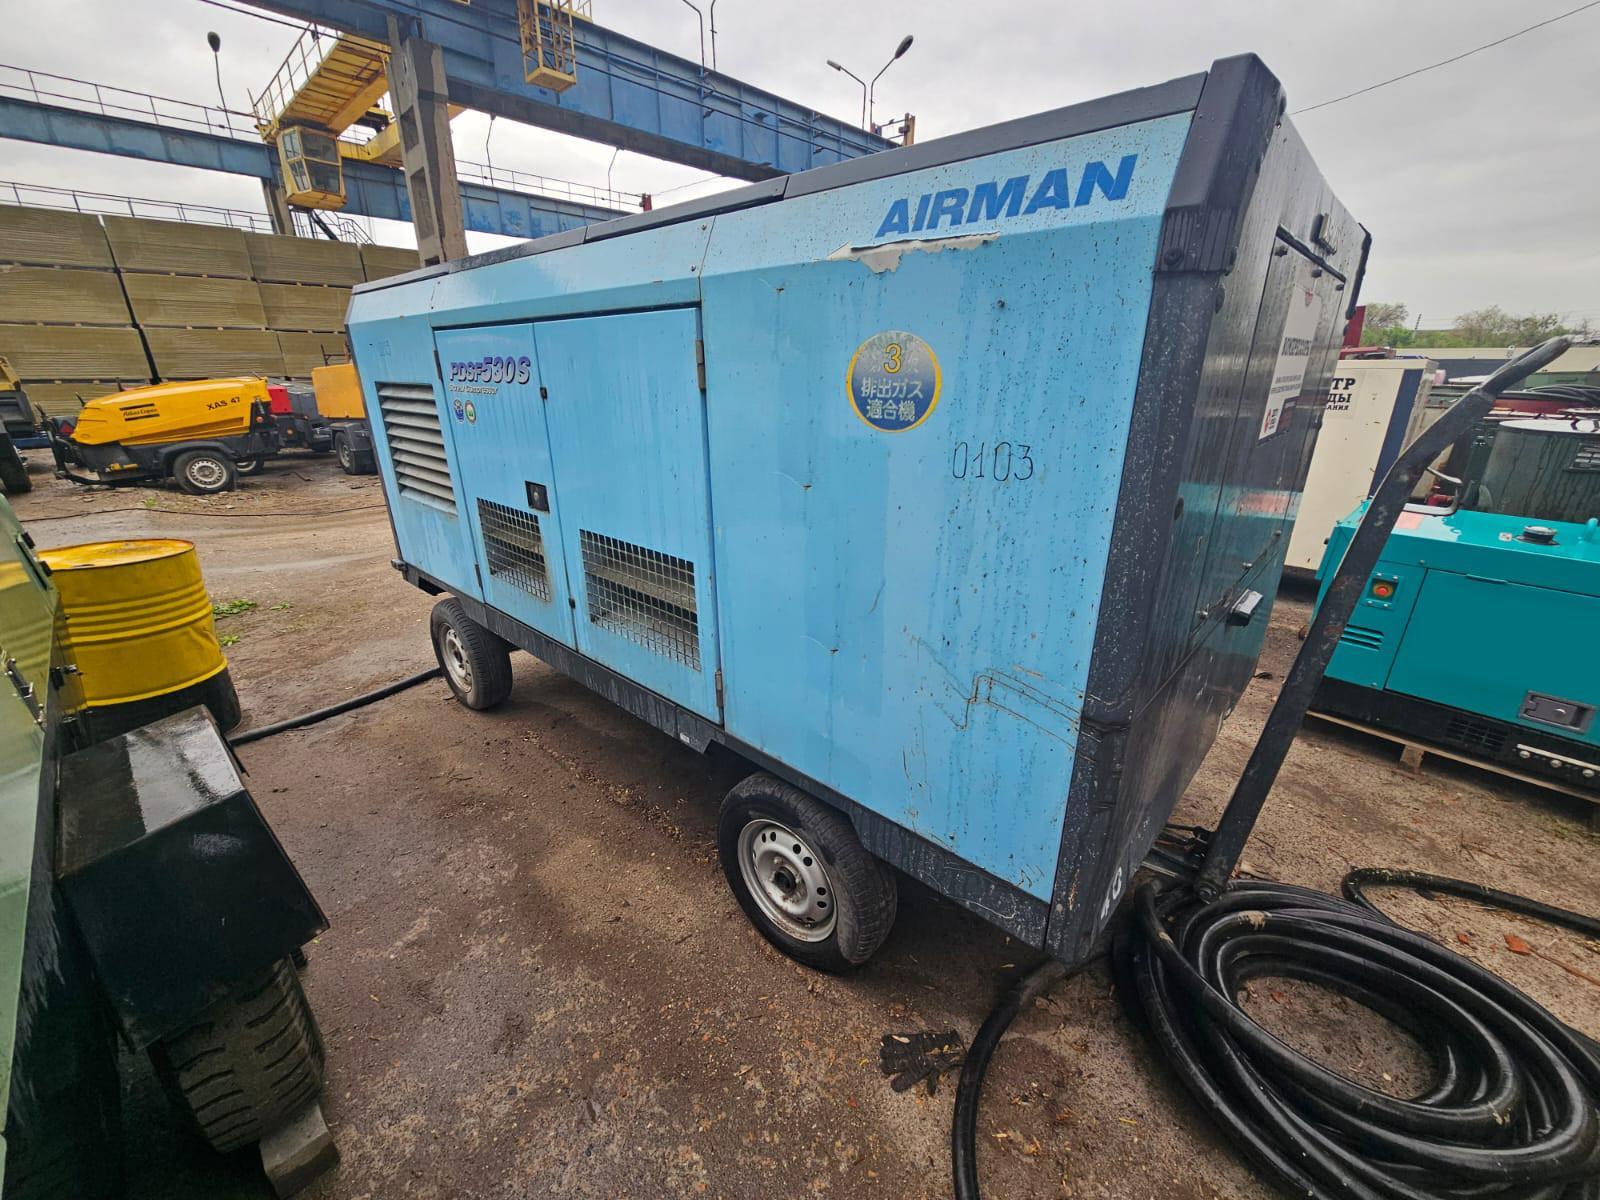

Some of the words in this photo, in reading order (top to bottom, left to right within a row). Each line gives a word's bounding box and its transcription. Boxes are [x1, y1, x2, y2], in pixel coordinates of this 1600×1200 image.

[875, 154, 1138, 238] AIRMAN
[884, 343, 902, 374] 3
[861, 377, 924, 399] 排出ガス
[206, 400, 228, 411] XAS
[230, 396, 241, 404] 47
[866, 399, 916, 422] 適合機
[953, 441, 1034, 482] 0103
